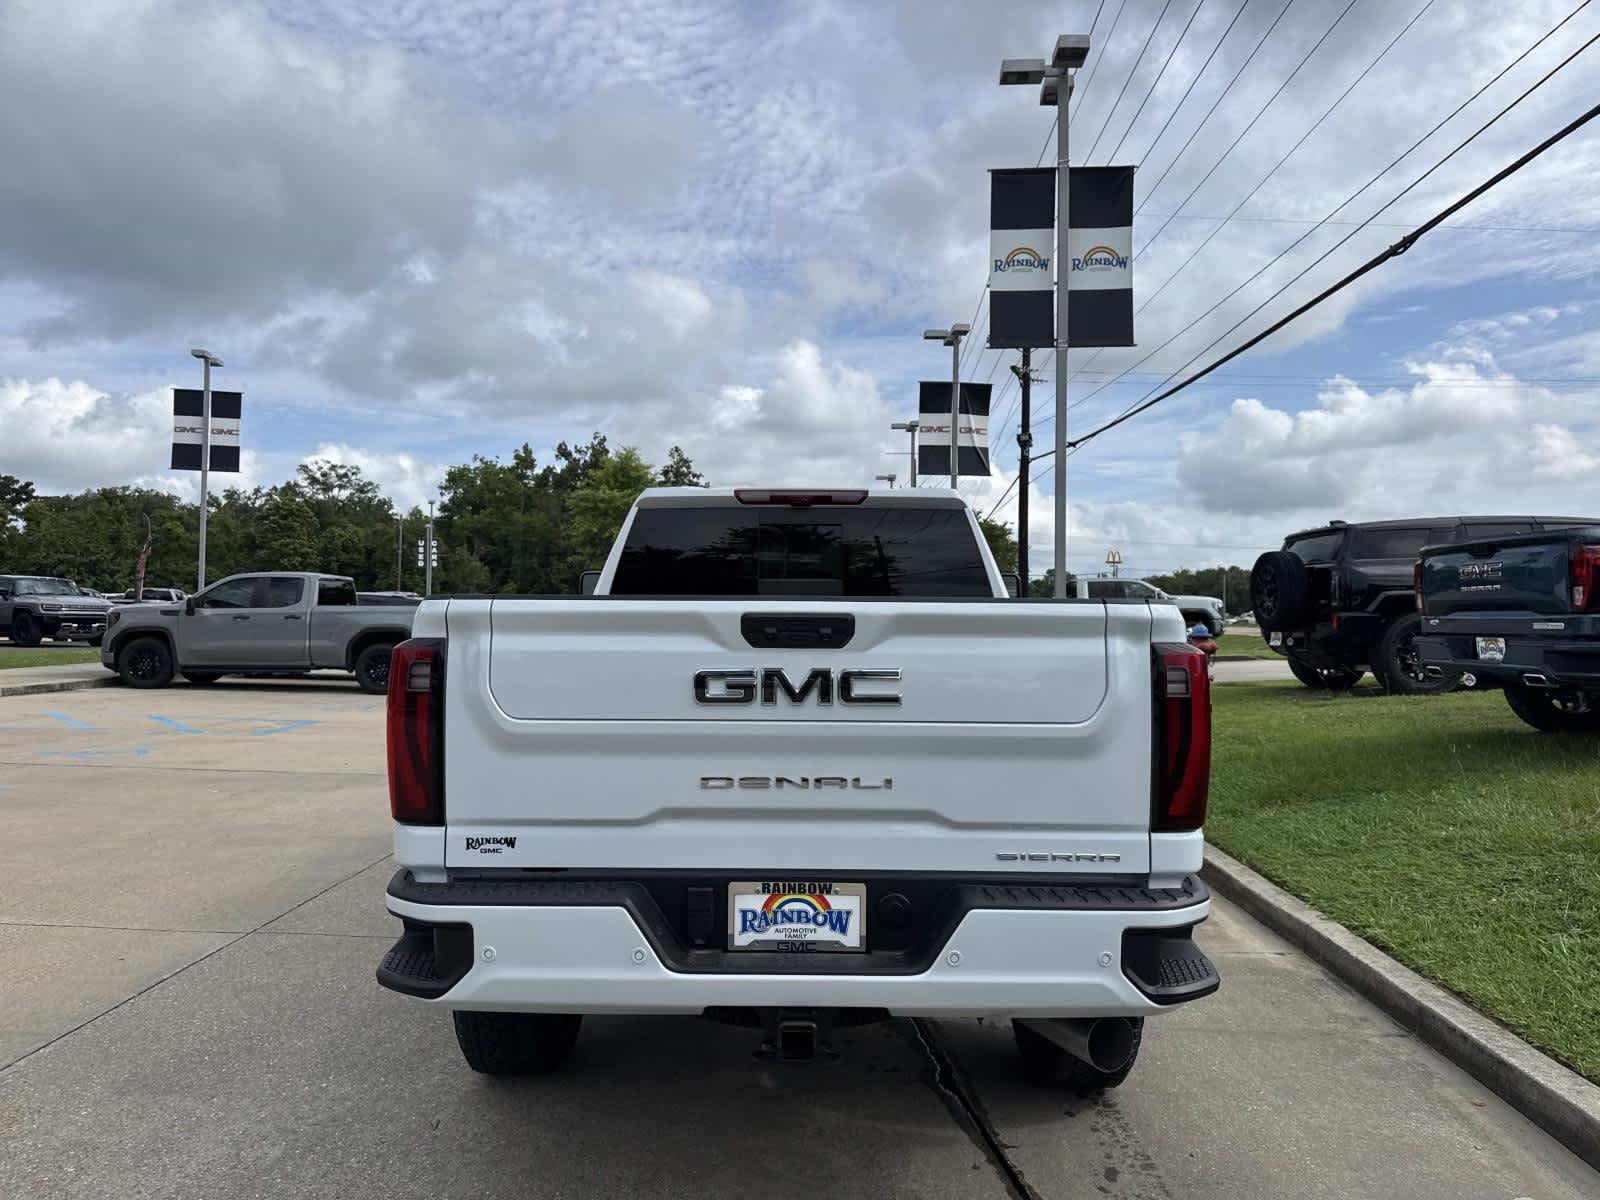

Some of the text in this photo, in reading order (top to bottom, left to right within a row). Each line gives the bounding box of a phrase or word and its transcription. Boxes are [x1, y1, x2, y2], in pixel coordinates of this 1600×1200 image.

[994, 258, 1050, 272] RAINBOW
[1071, 256, 1129, 271] RAINBOW
[1458, 563, 1503, 579] GMC
[693, 667, 903, 706] GMC
[700, 776, 893, 790] DENALI
[465, 836, 517, 851] RAINBOW
[996, 852, 1121, 863] SIERRA
[761, 882, 832, 895] RAINBOW
[739, 908, 852, 936] RAINBOW
[776, 941, 817, 952] GMC
